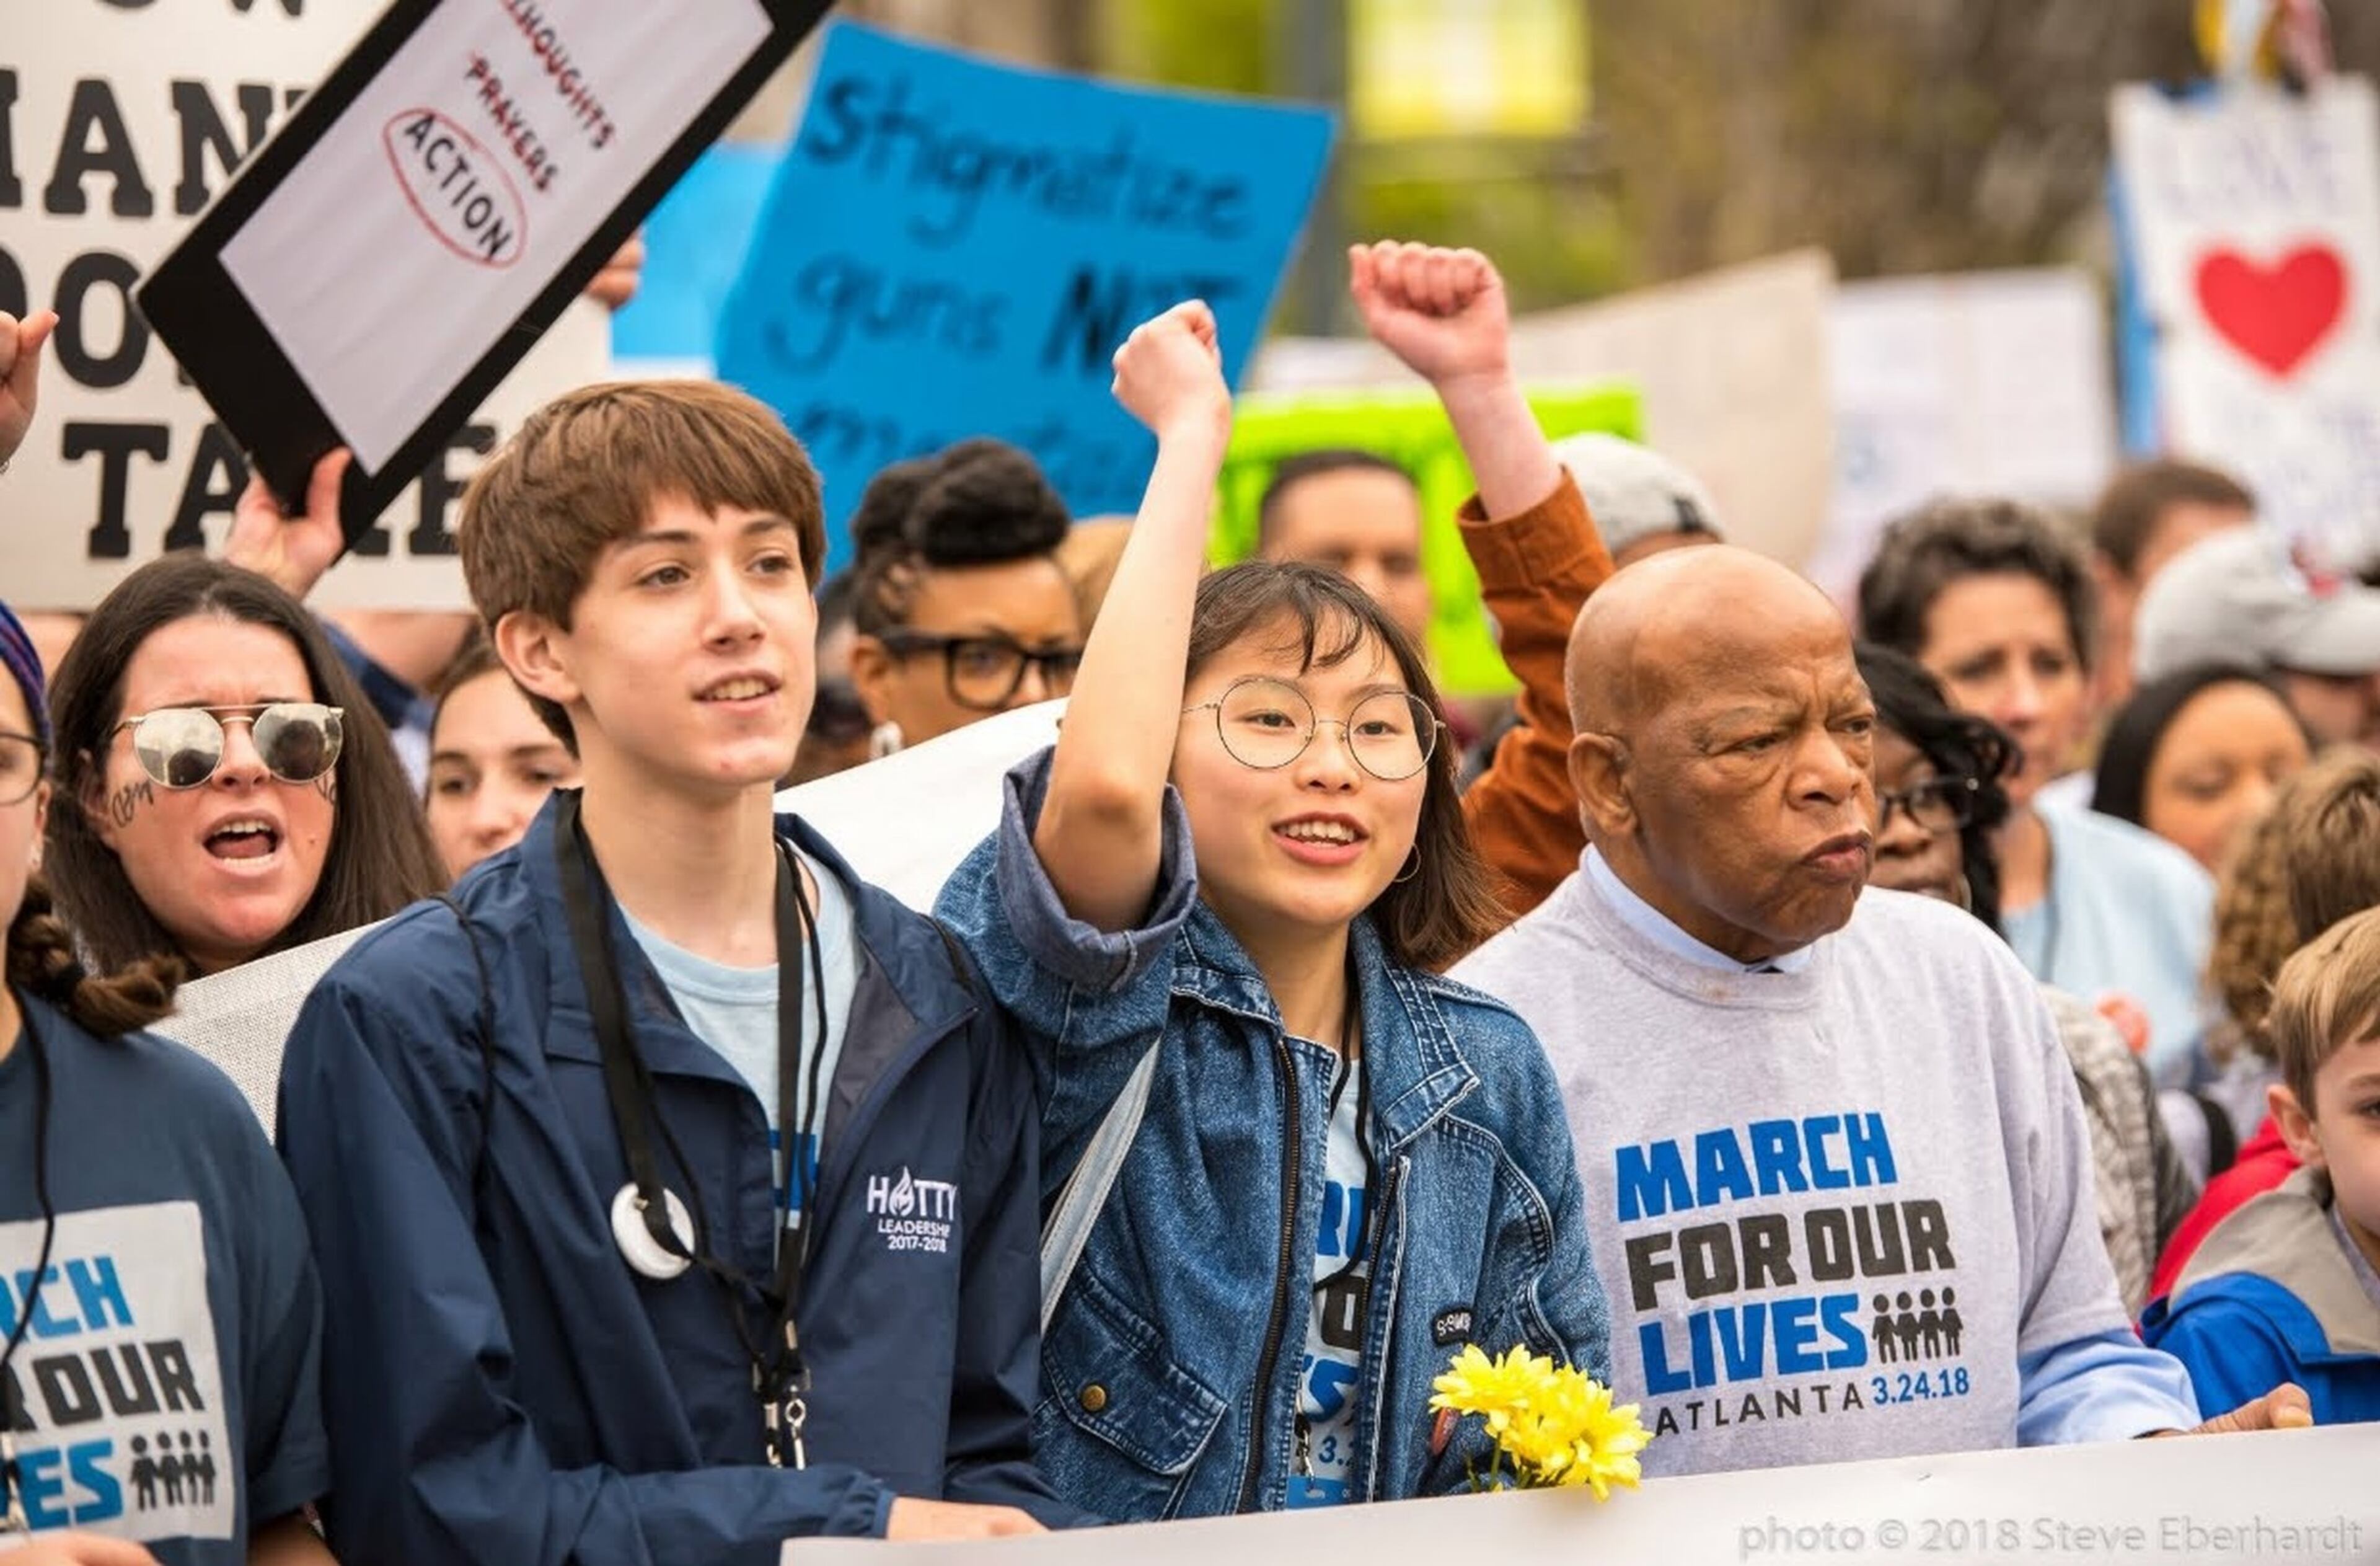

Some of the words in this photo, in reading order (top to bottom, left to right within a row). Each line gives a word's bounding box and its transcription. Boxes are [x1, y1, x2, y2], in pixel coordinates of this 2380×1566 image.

[405, 113, 512, 259] ACTION
[761, 253, 1010, 373] guns
[1615, 1112, 1898, 1223] MARCH
[1625, 1213, 1797, 1312] FOR
[1804, 1199, 1956, 1282] OUR
[32, 1339, 206, 1427] OUR
[1639, 1293, 1868, 1397] LIVES
[1655, 1383, 1864, 1437] ATLANTA
[1871, 1366, 1970, 1406] 3.24.18
